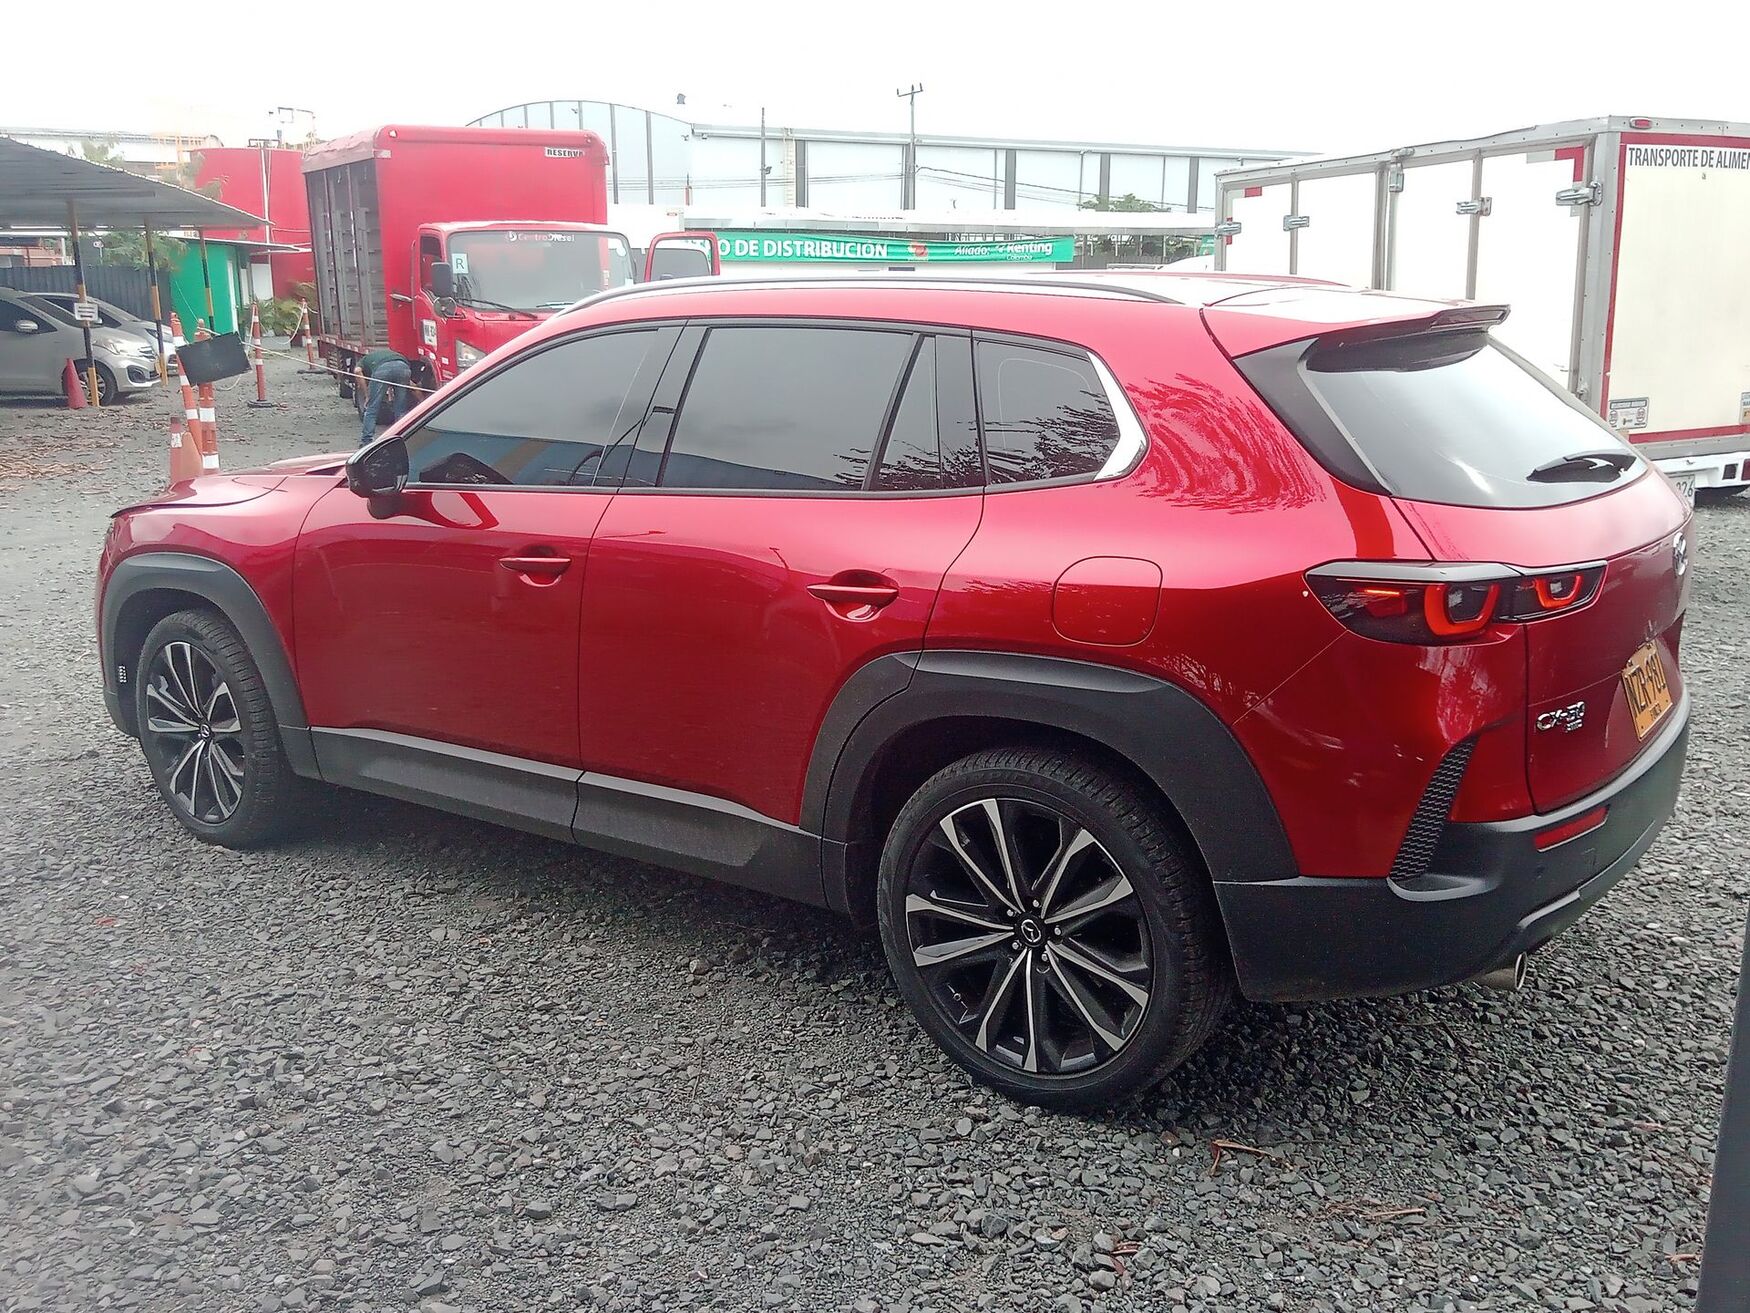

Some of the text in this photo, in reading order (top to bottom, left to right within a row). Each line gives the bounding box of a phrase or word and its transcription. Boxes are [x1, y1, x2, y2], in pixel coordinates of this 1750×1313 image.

[1628, 147, 1699, 167] TRANSPORTE
[1700, 149, 1715, 168] DE
[735, 239, 759, 257] DE
[763, 240, 888, 257] DISTRIBUCIÓN
[456, 257, 465, 270] R
